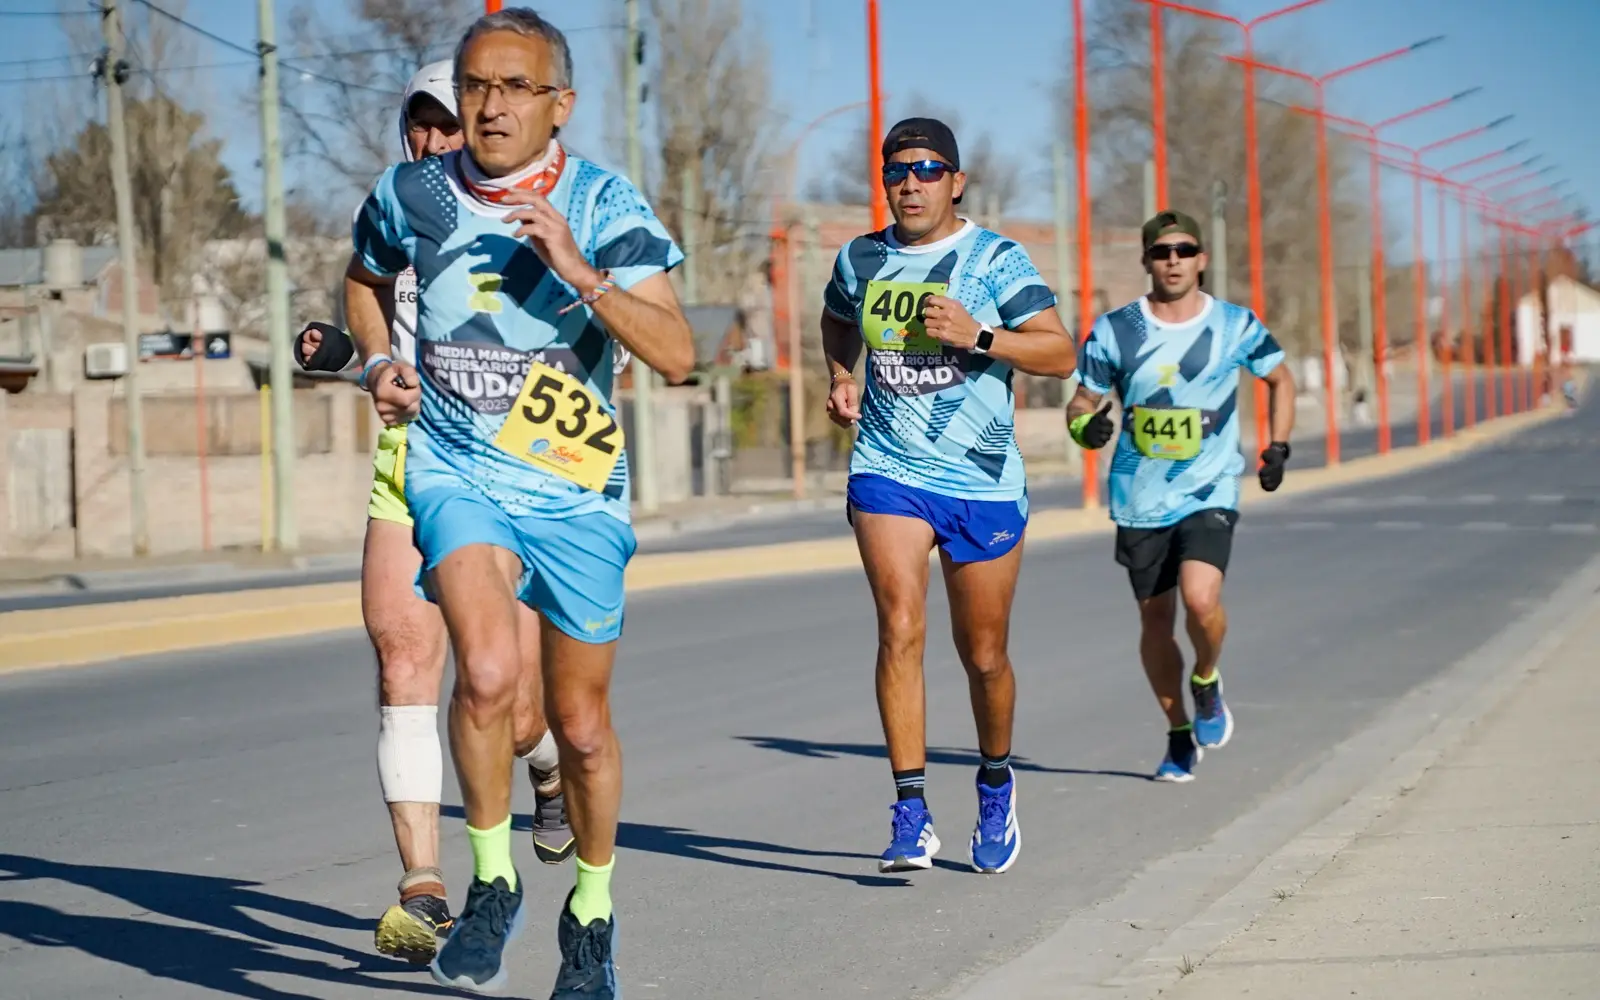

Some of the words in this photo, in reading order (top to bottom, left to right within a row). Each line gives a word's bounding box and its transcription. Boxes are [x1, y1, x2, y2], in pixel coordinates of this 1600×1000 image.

[395, 291, 417, 303] EG
[434, 344, 475, 360] MEDIA
[478, 349, 545, 363] MARAN
[927, 356, 942, 366] DE
[944, 356, 958, 365] LA
[434, 369, 526, 399] CIUDA
[873, 365, 953, 385] CIUDAD
[897, 386, 919, 394] 2025
[478, 399, 509, 411] 2025
[522, 374, 618, 455] 532
[1142, 416, 1193, 440] 441
